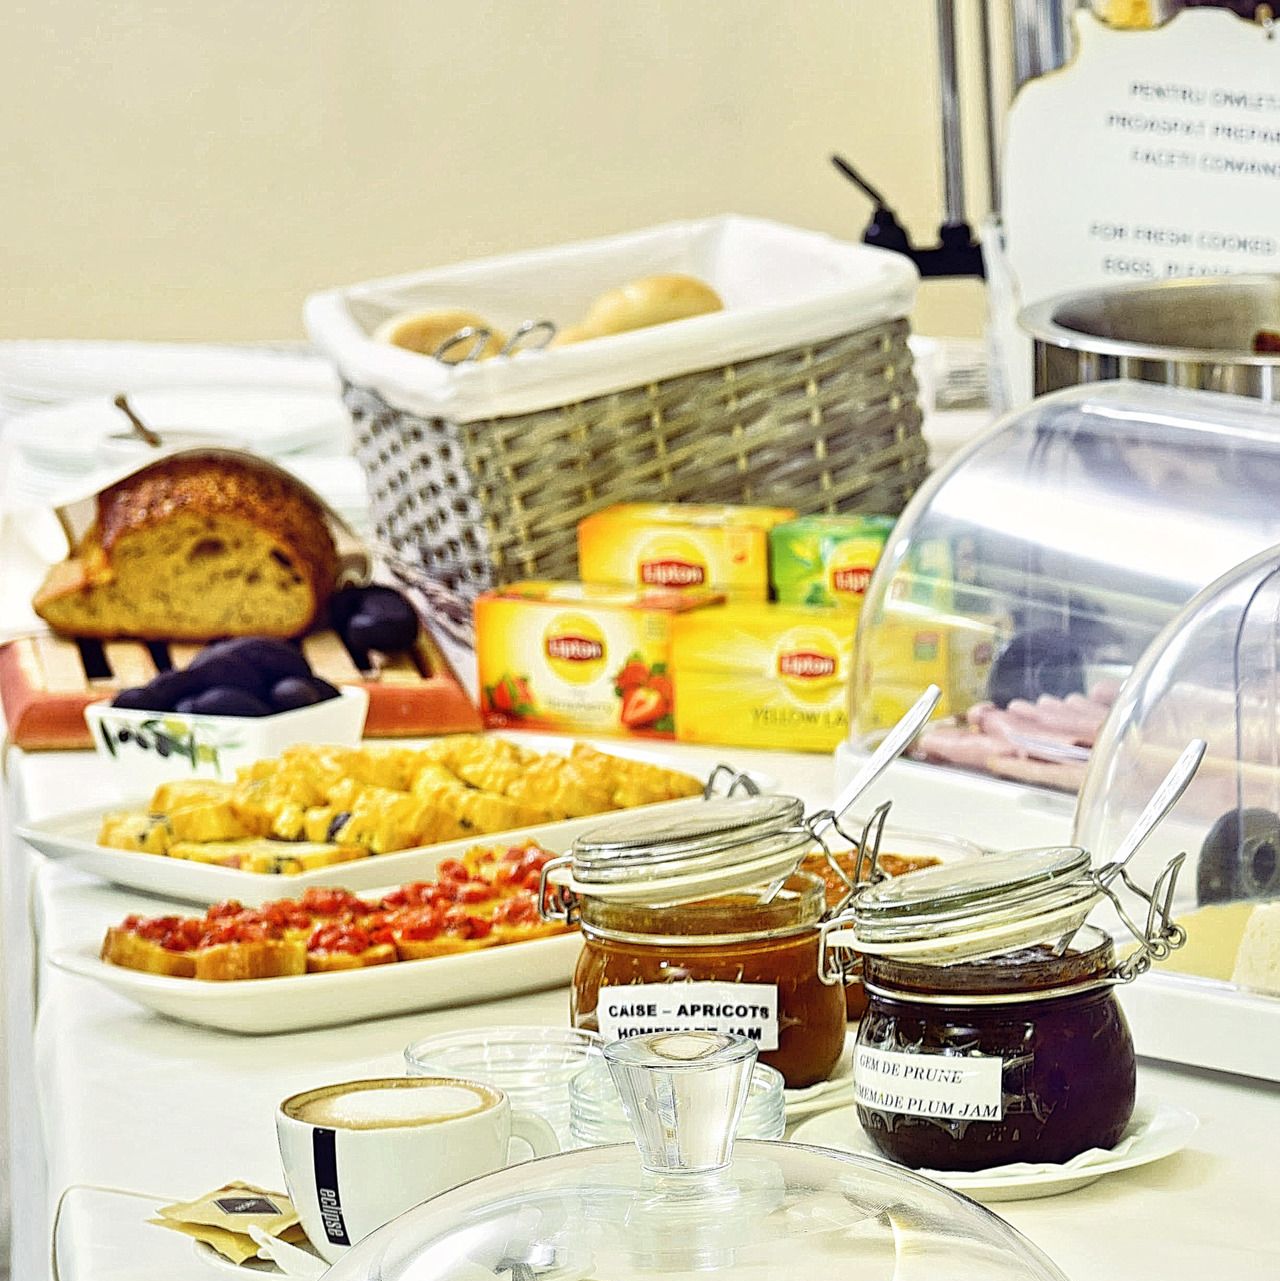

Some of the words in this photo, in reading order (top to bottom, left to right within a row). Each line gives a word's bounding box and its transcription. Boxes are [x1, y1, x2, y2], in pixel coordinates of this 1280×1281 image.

[608, 1004, 657, 1018] CAISE
[676, 1004, 769, 1019] APRICOTS
[860, 1054, 879, 1072] GEM
[882, 1061, 899, 1077] DE
[903, 1066, 964, 1084] PRUNE
[857, 1083, 903, 1110] MEMADE
[907, 1098, 954, 1116] PLUM
[958, 1103, 999, 1118] JAM
[320, 1188, 344, 1237] eclipse
